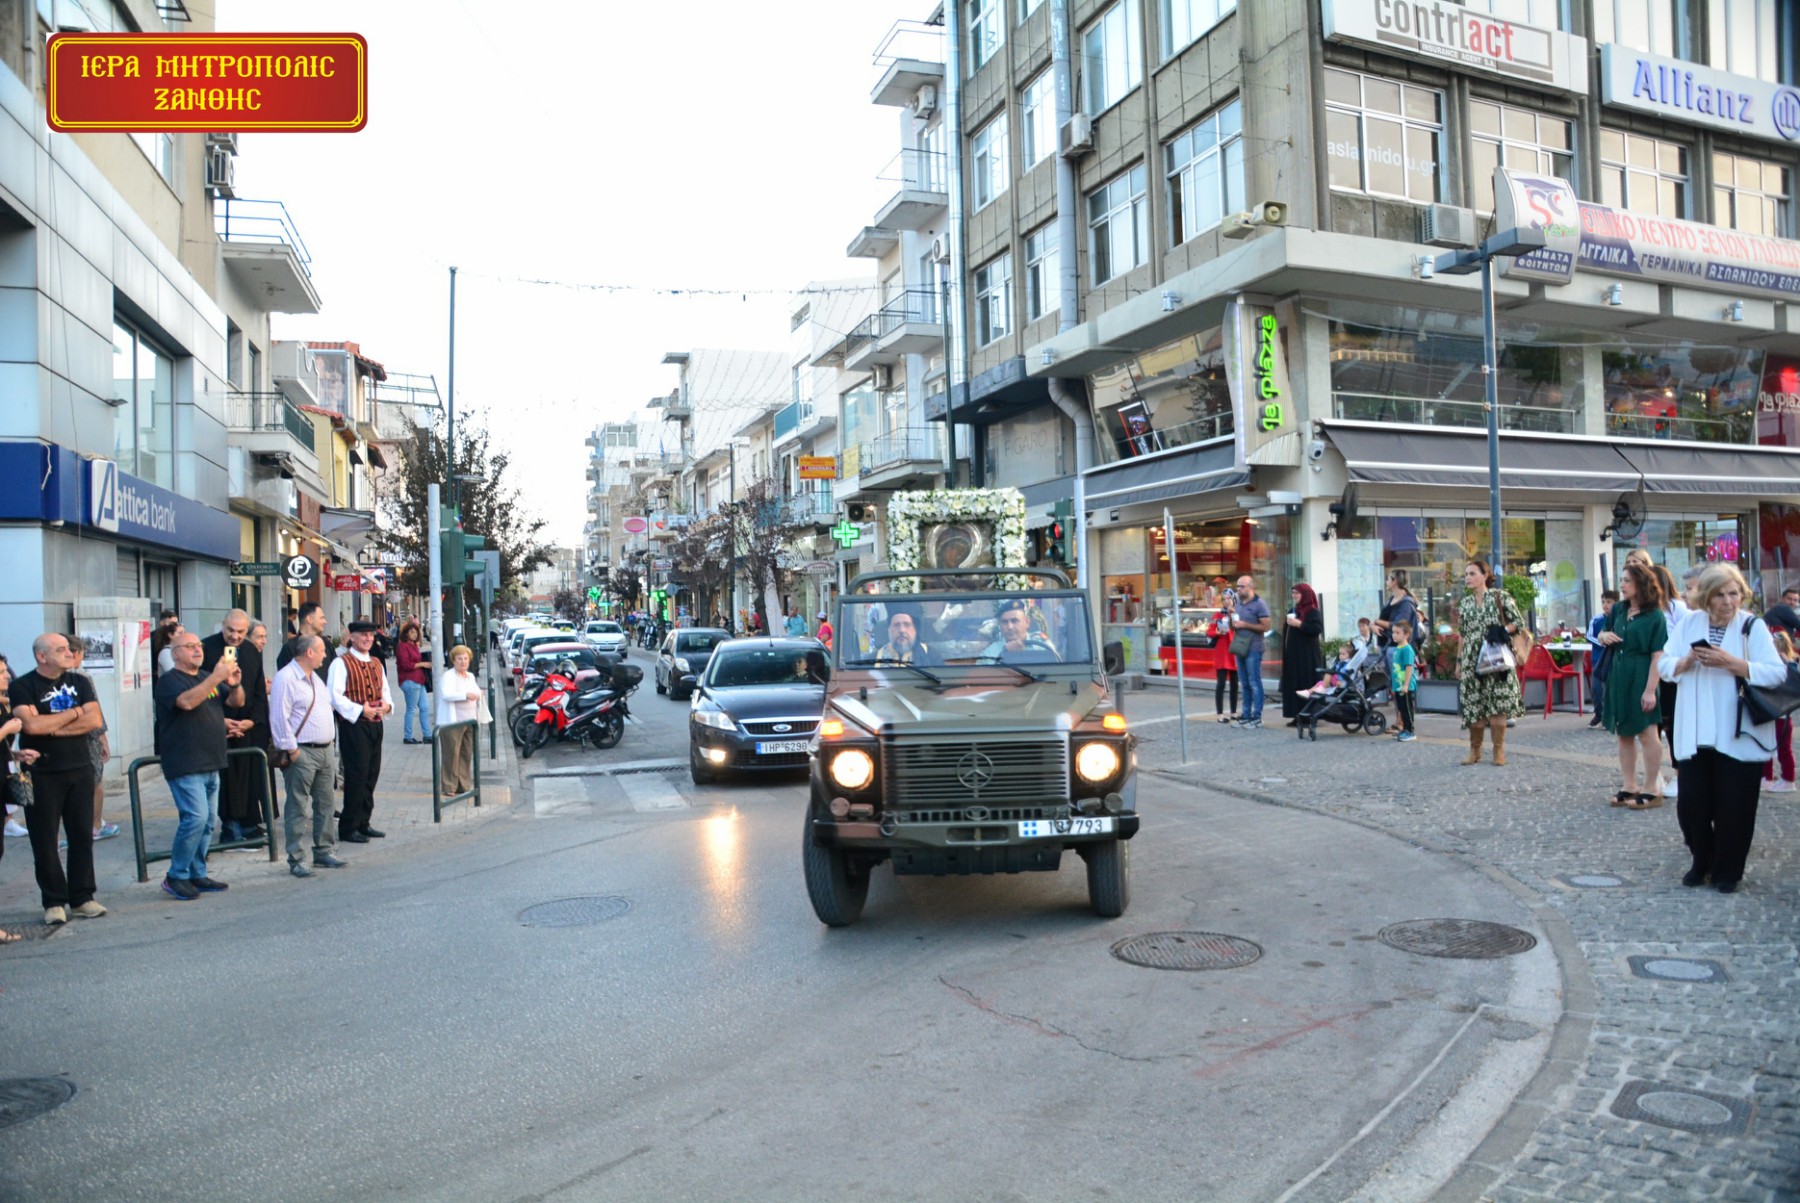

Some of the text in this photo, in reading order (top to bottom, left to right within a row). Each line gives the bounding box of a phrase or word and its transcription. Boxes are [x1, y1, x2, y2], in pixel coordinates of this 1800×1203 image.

[1421, 43, 1459, 59] INSURANCE
[1461, 52, 1482, 64] AGENT
[1633, 59, 1755, 124] Allianz
[1581, 206, 1636, 241] ΕΙΔΙΚΟ
[1637, 218, 1697, 252] ΚΕΝΤΡΟ
[1699, 229, 1751, 263] ΞΕΝΩΝ
[1518, 258, 1568, 273] ΦΟΙΤΗΤΩΝ
[1578, 242, 1628, 266] ΑΓΓΛΙΚΑ
[1640, 253, 1702, 277] ΓΕΡΜΑΝΙΚΑ
[1778, 276, 1800, 291] ΕΠΕ
[117, 485, 176, 533] attica bank
